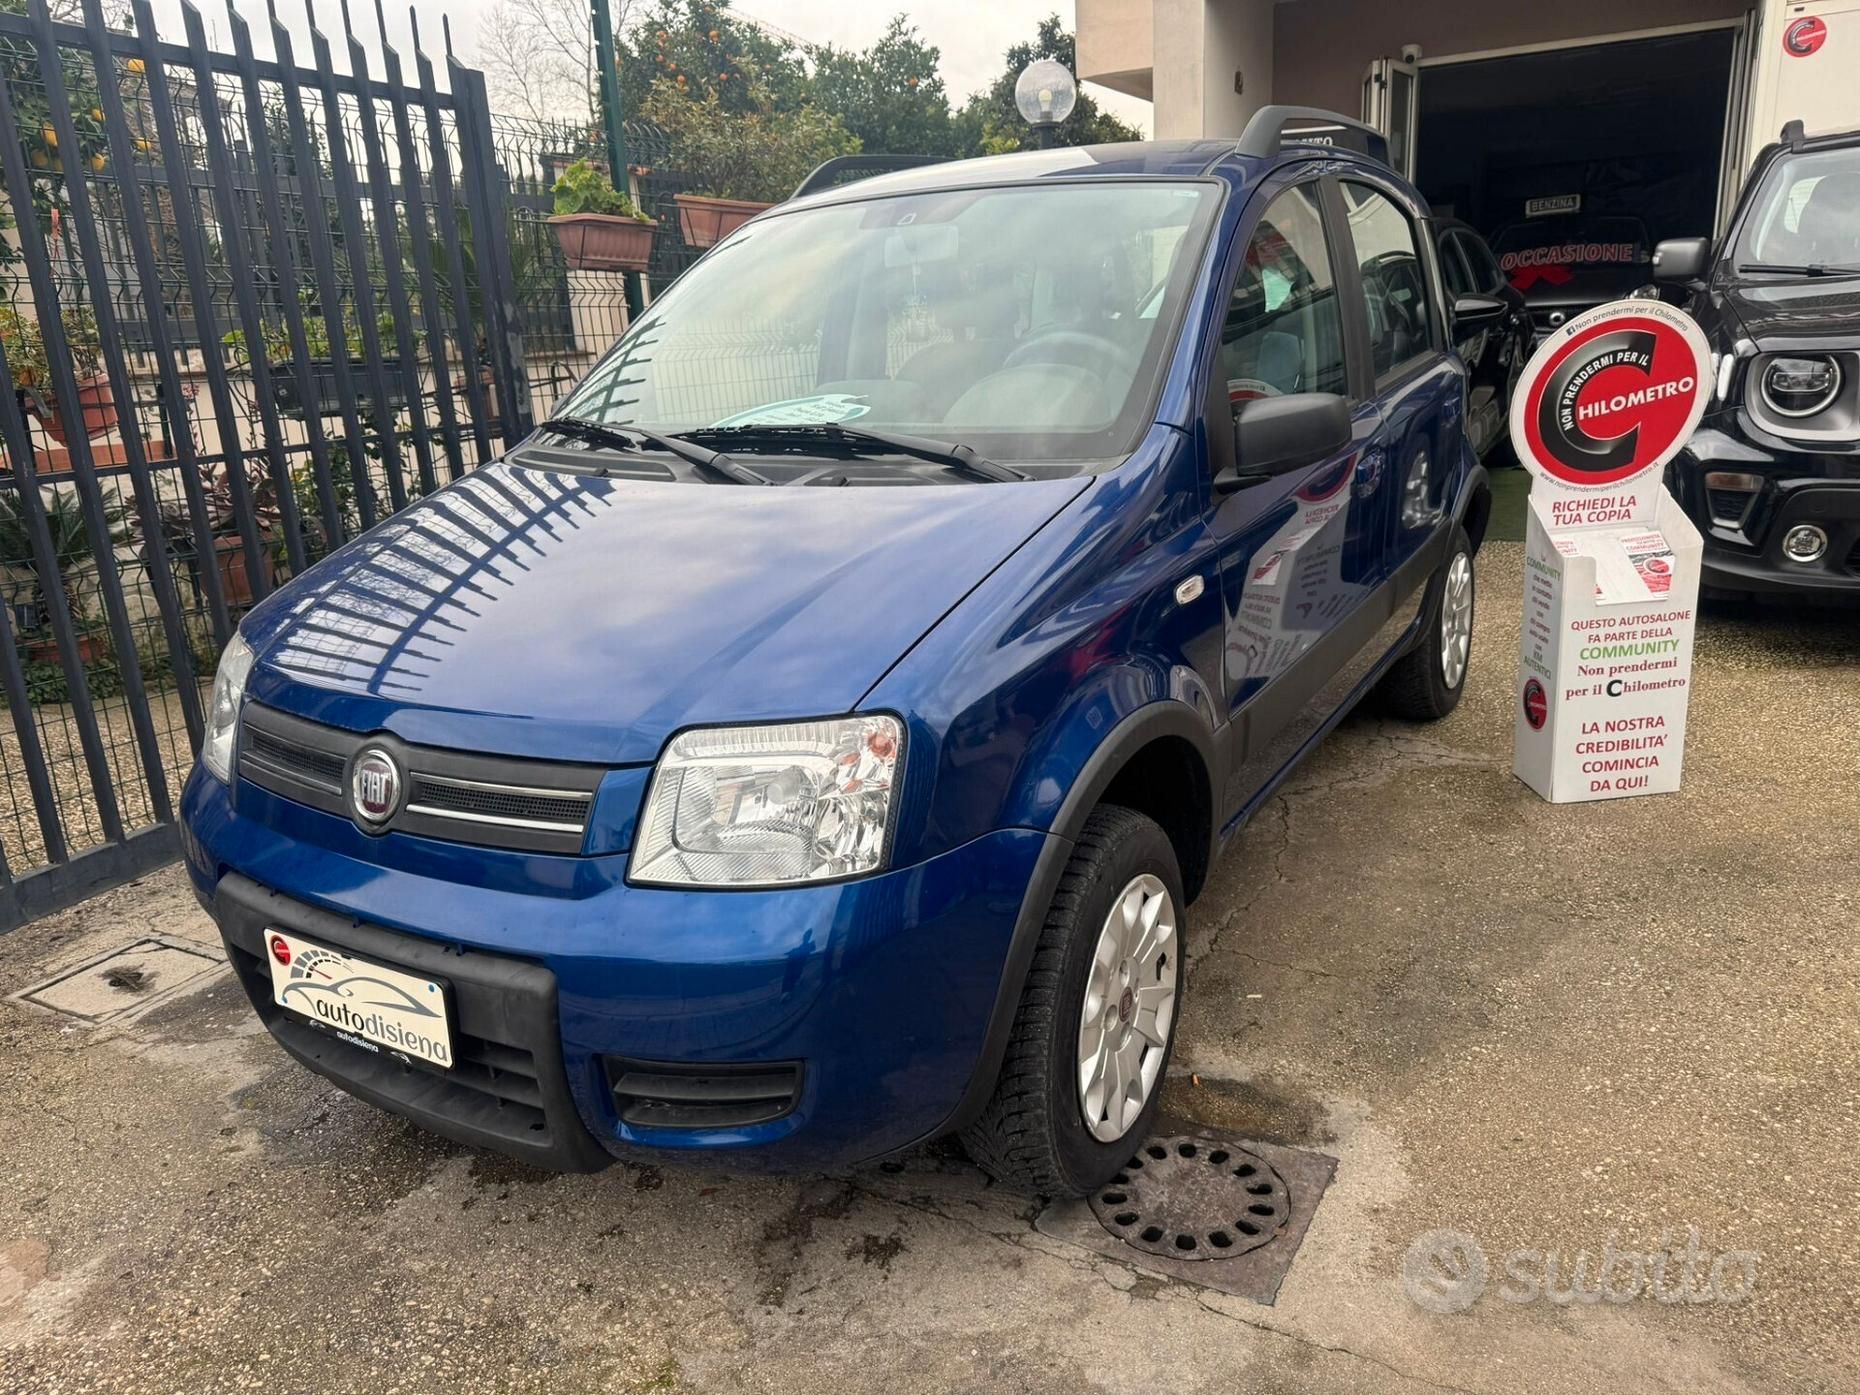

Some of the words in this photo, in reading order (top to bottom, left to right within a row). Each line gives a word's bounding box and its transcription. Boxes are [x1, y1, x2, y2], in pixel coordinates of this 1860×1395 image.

[1531, 197, 1574, 211] BENZINA
[1501, 243, 1632, 270] OCCASIONE
[1575, 319, 1593, 333] Non
[1593, 305, 1634, 322] prendermi
[1635, 306, 1648, 314] per
[1655, 308, 1689, 332] Chilometro
[1616, 351, 1638, 363] PER
[1638, 353, 1649, 366] IL
[1563, 354, 1613, 405] PRENDERMI
[1561, 408, 1575, 431] NON
[1552, 497, 1616, 513] RICHIEDI
[1619, 495, 1637, 508] LA
[1553, 512, 1583, 526] TUA
[1587, 508, 1631, 522] COPIA
[1571, 618, 1616, 632] QUESTO
[1618, 610, 1691, 627] AUTOSALONE
[1588, 634, 1601, 644] FA
[1604, 630, 1638, 643] PARTE
[1640, 627, 1673, 639] DELLA
[1580, 639, 1679, 660] COMMUNITY
[1577, 664, 1605, 677] Non
[1609, 656, 1677, 677] prendermi
[1565, 687, 1589, 701] per
[1592, 684, 1602, 695] il
[1606, 678, 1686, 698] Chilometro
[1582, 722, 1600, 735] LA
[1604, 715, 1665, 733] NOSTRA
[1582, 755, 1659, 773] COMINCIA
[362, 769, 392, 804] FIAT
[1590, 780, 1611, 792] DA
[1615, 775, 1649, 791] QUI!
[316, 999, 448, 1062] autodisiena
[336, 1030, 379, 1053] autodisiena
